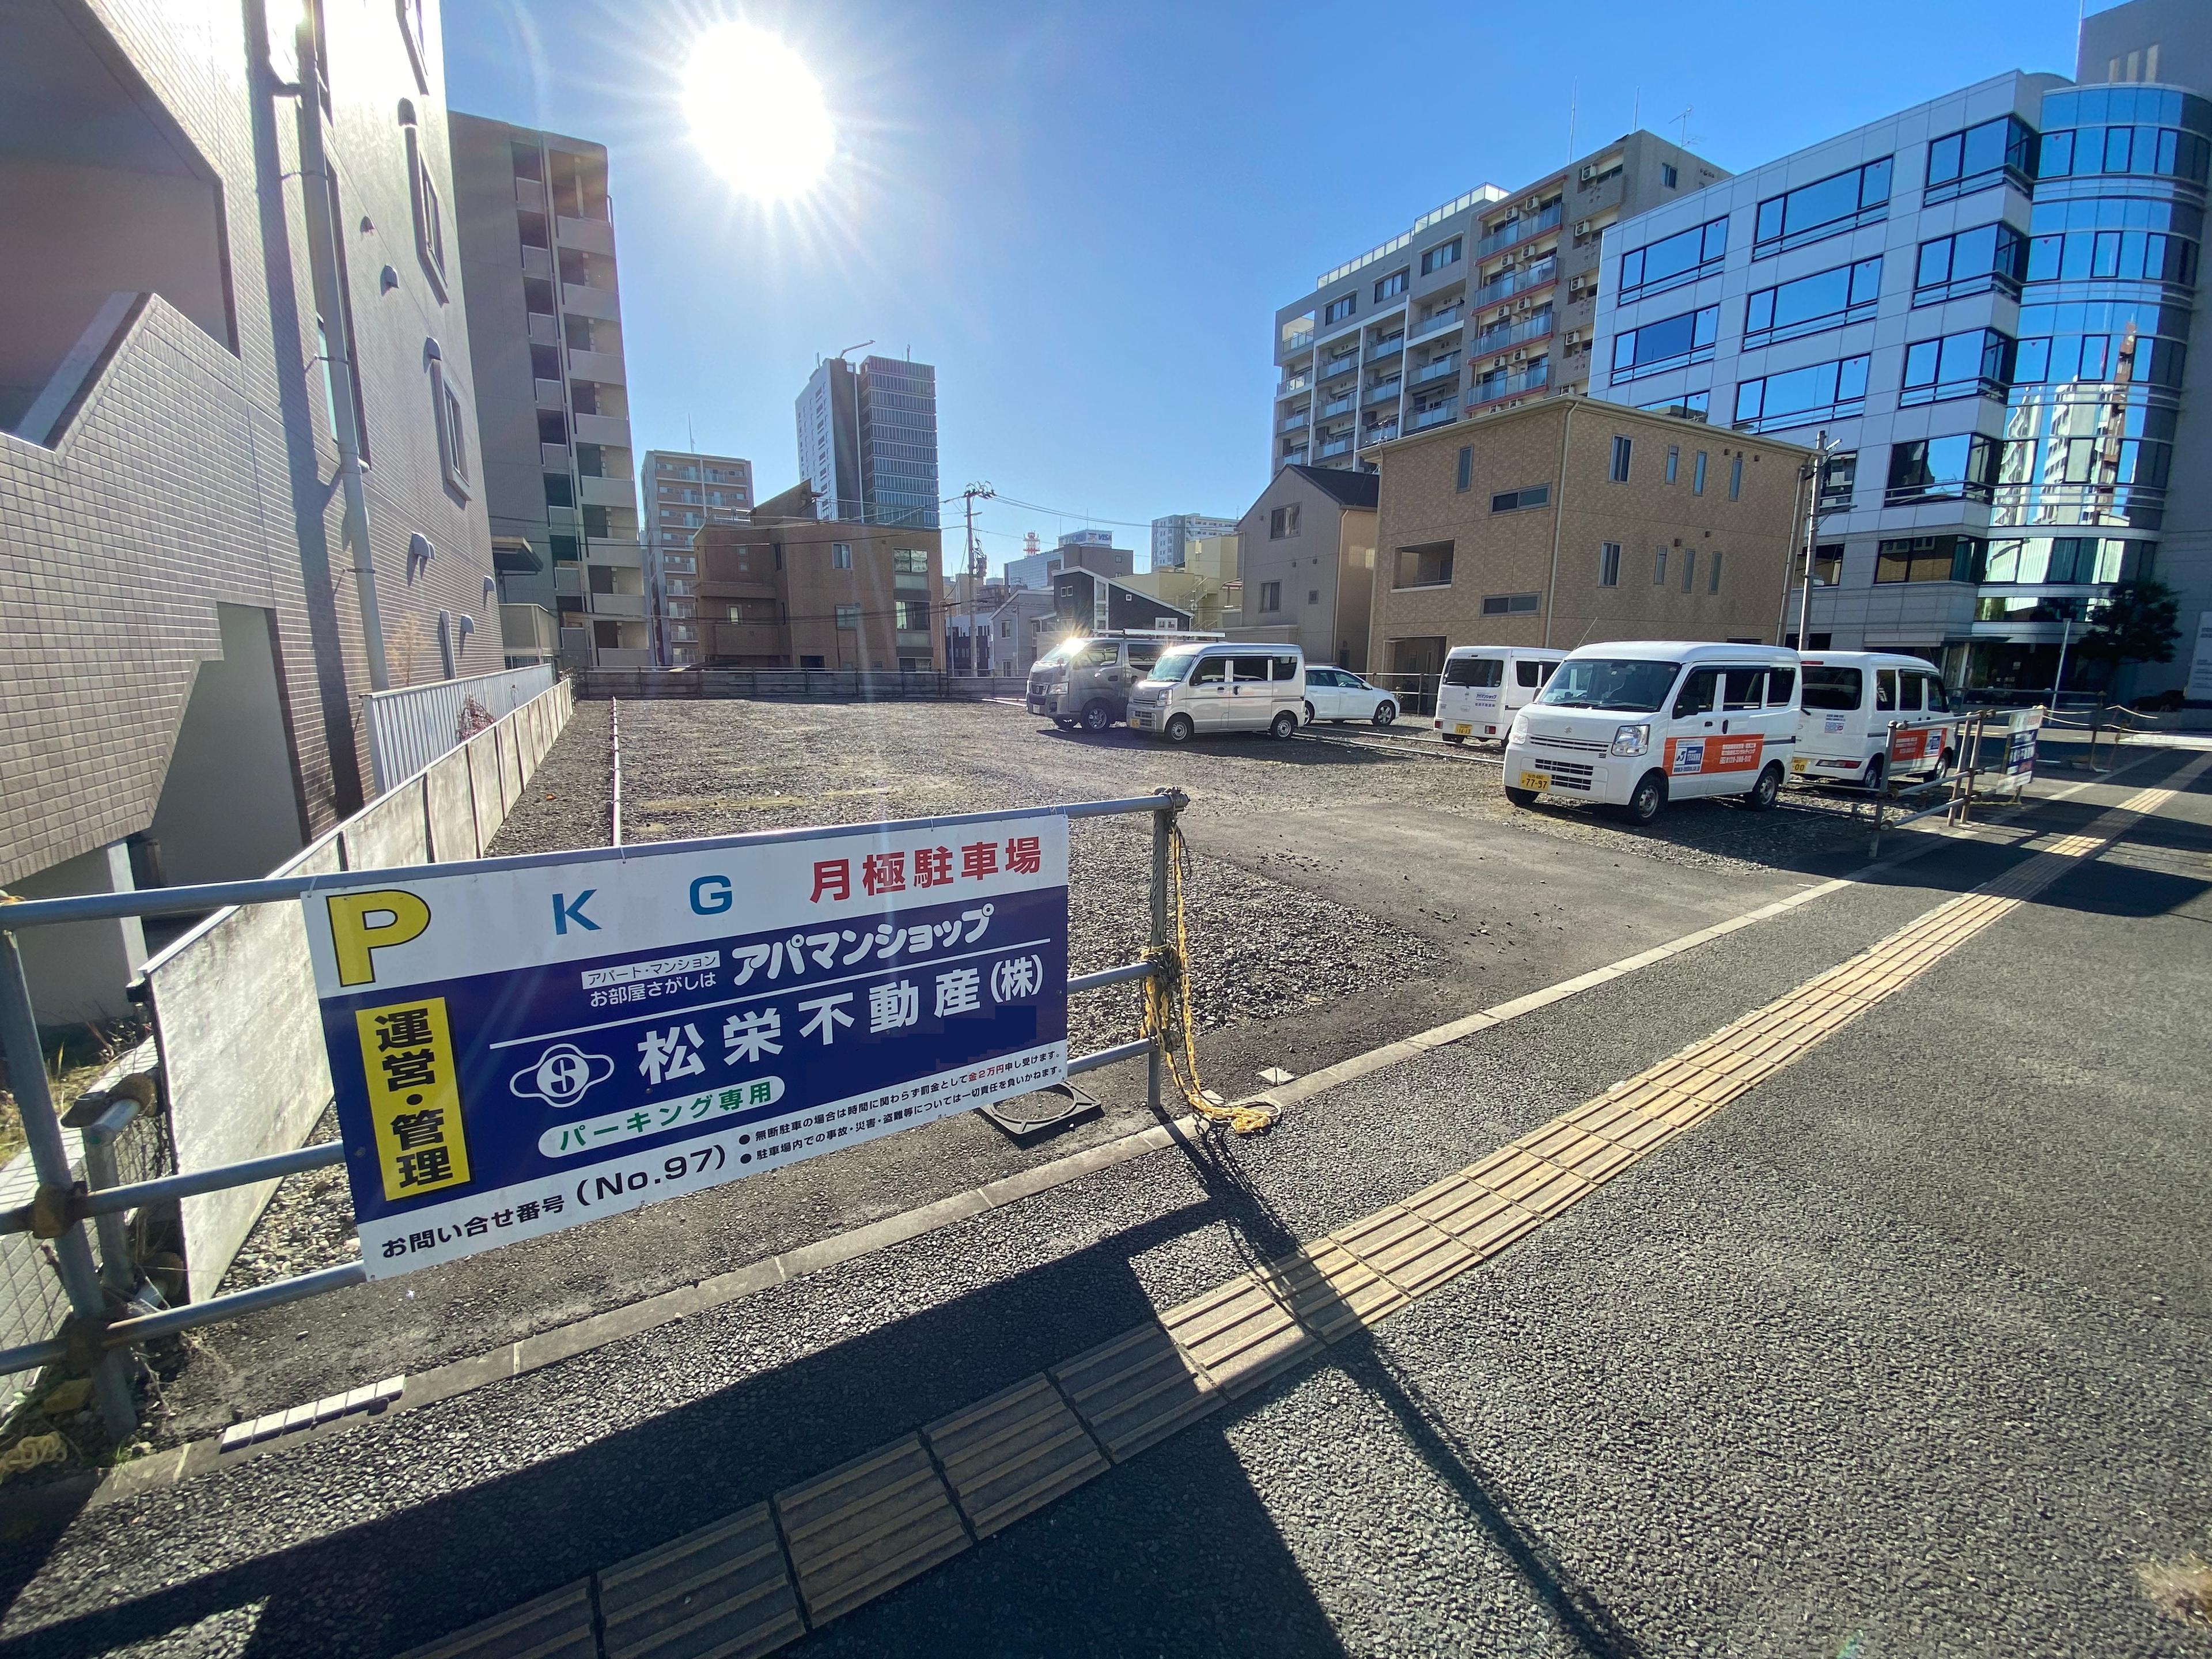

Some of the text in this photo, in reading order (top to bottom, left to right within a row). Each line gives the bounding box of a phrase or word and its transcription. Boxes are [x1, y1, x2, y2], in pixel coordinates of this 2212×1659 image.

[1526, 778, 1548, 789] 77-97
[552, 874, 733, 935] K G
[809, 836, 1041, 904] 月極駐車場
[325, 888, 431, 987] P
[588, 956, 716, 986] アパート・マンション
[732, 903, 995, 986] アパマンショップ
[590, 972, 717, 1007] お部屋さがしは
[374, 1007, 454, 1188] 運営・管理
[559, 1081, 771, 1151] パーキング専用
[382, 1144, 726, 1259] お問い合せ番号 (No.97)
